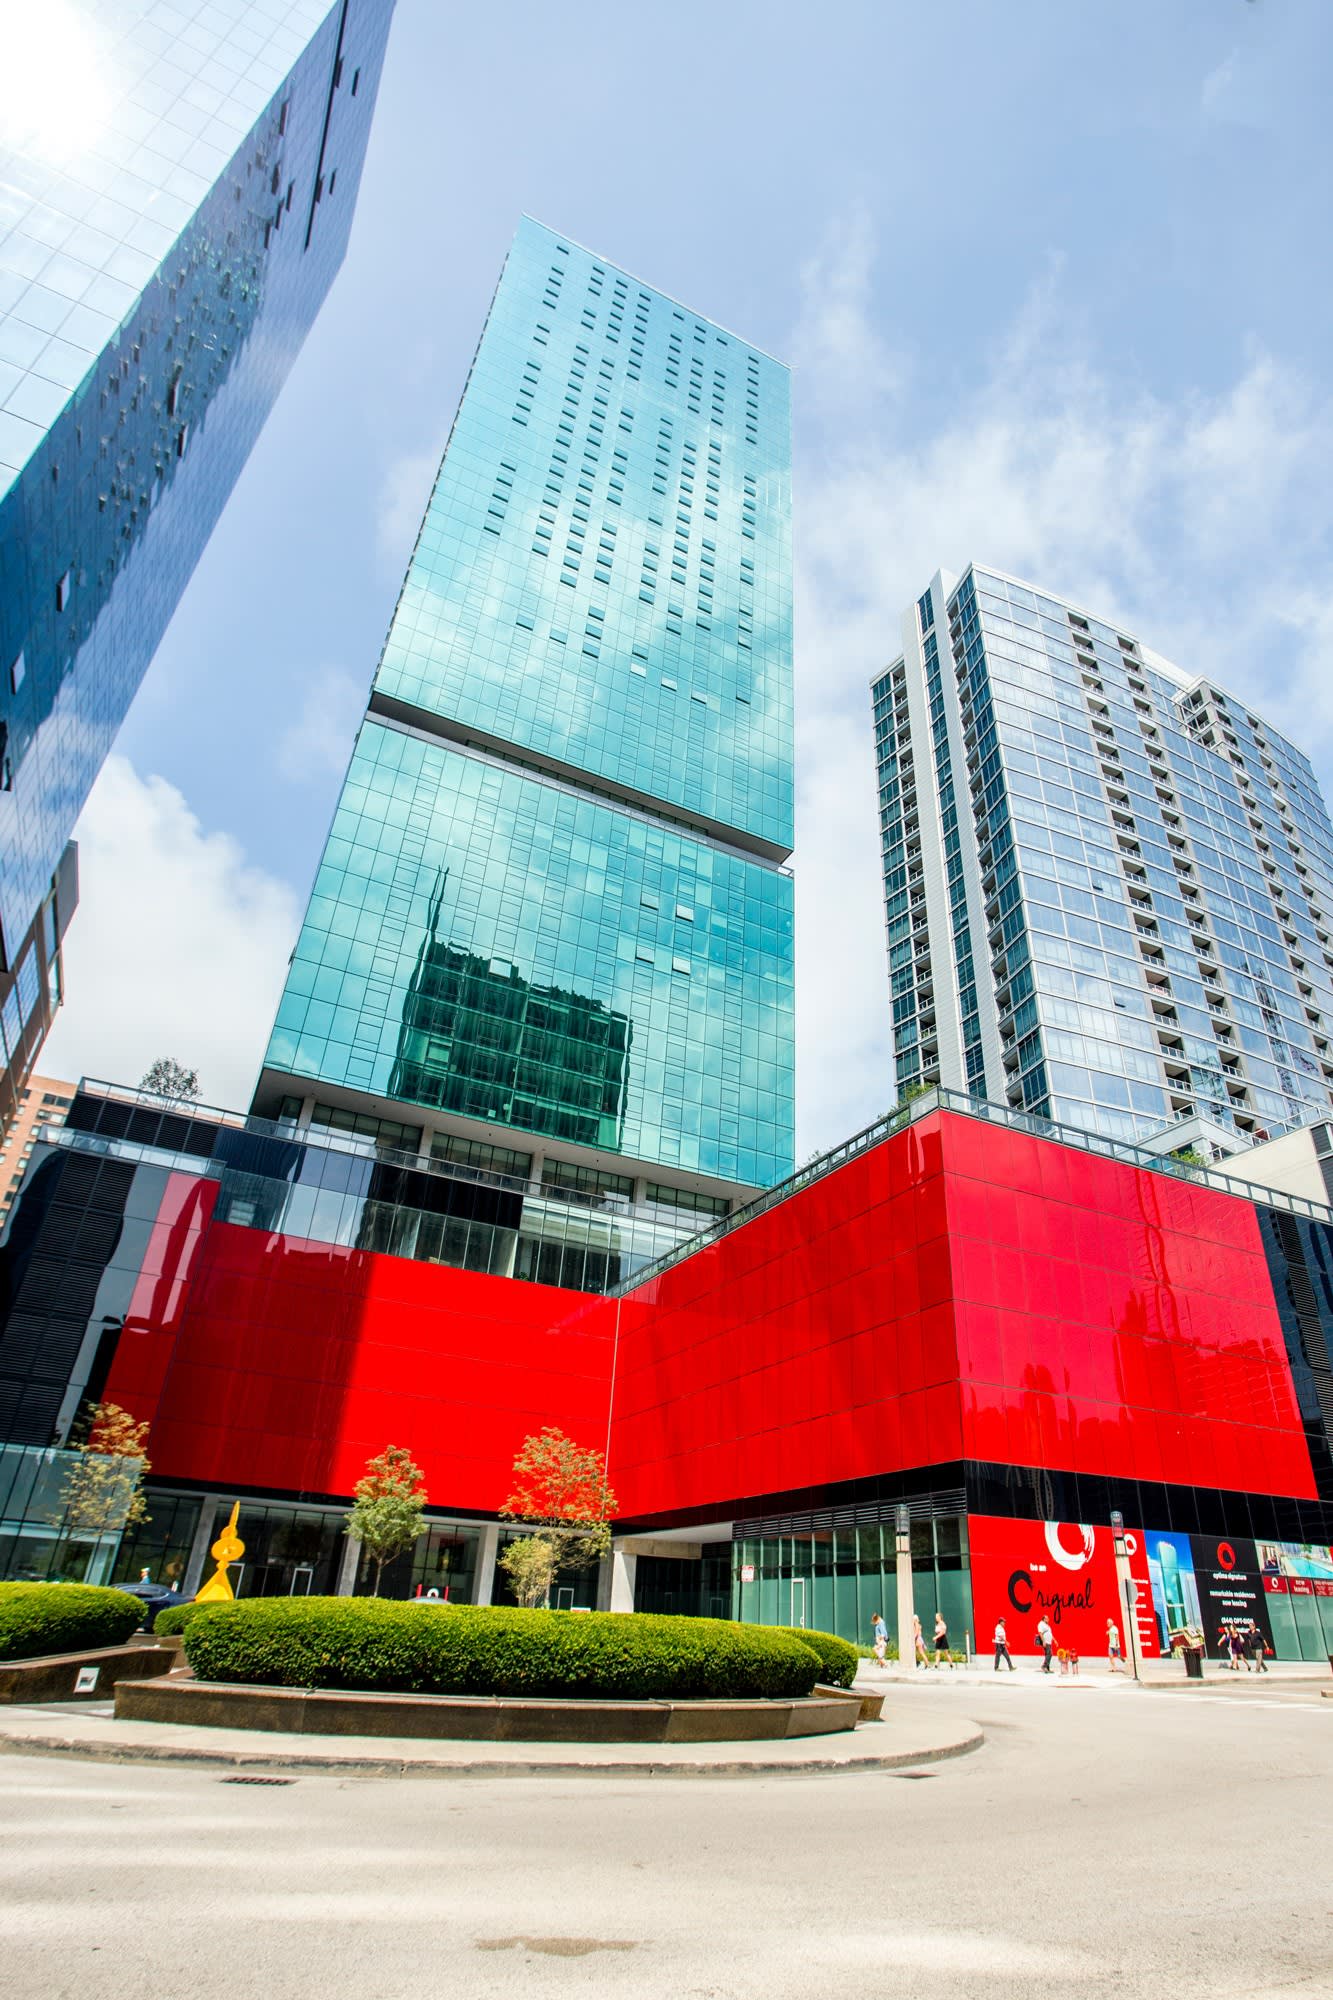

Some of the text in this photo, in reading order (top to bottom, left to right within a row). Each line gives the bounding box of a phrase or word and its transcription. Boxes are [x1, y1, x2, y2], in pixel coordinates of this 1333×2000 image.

[1030, 1563, 1038, 1571] be
[1213, 1572, 1247, 1581] optima signature
[1231, 1600, 1247, 1608] leasing
